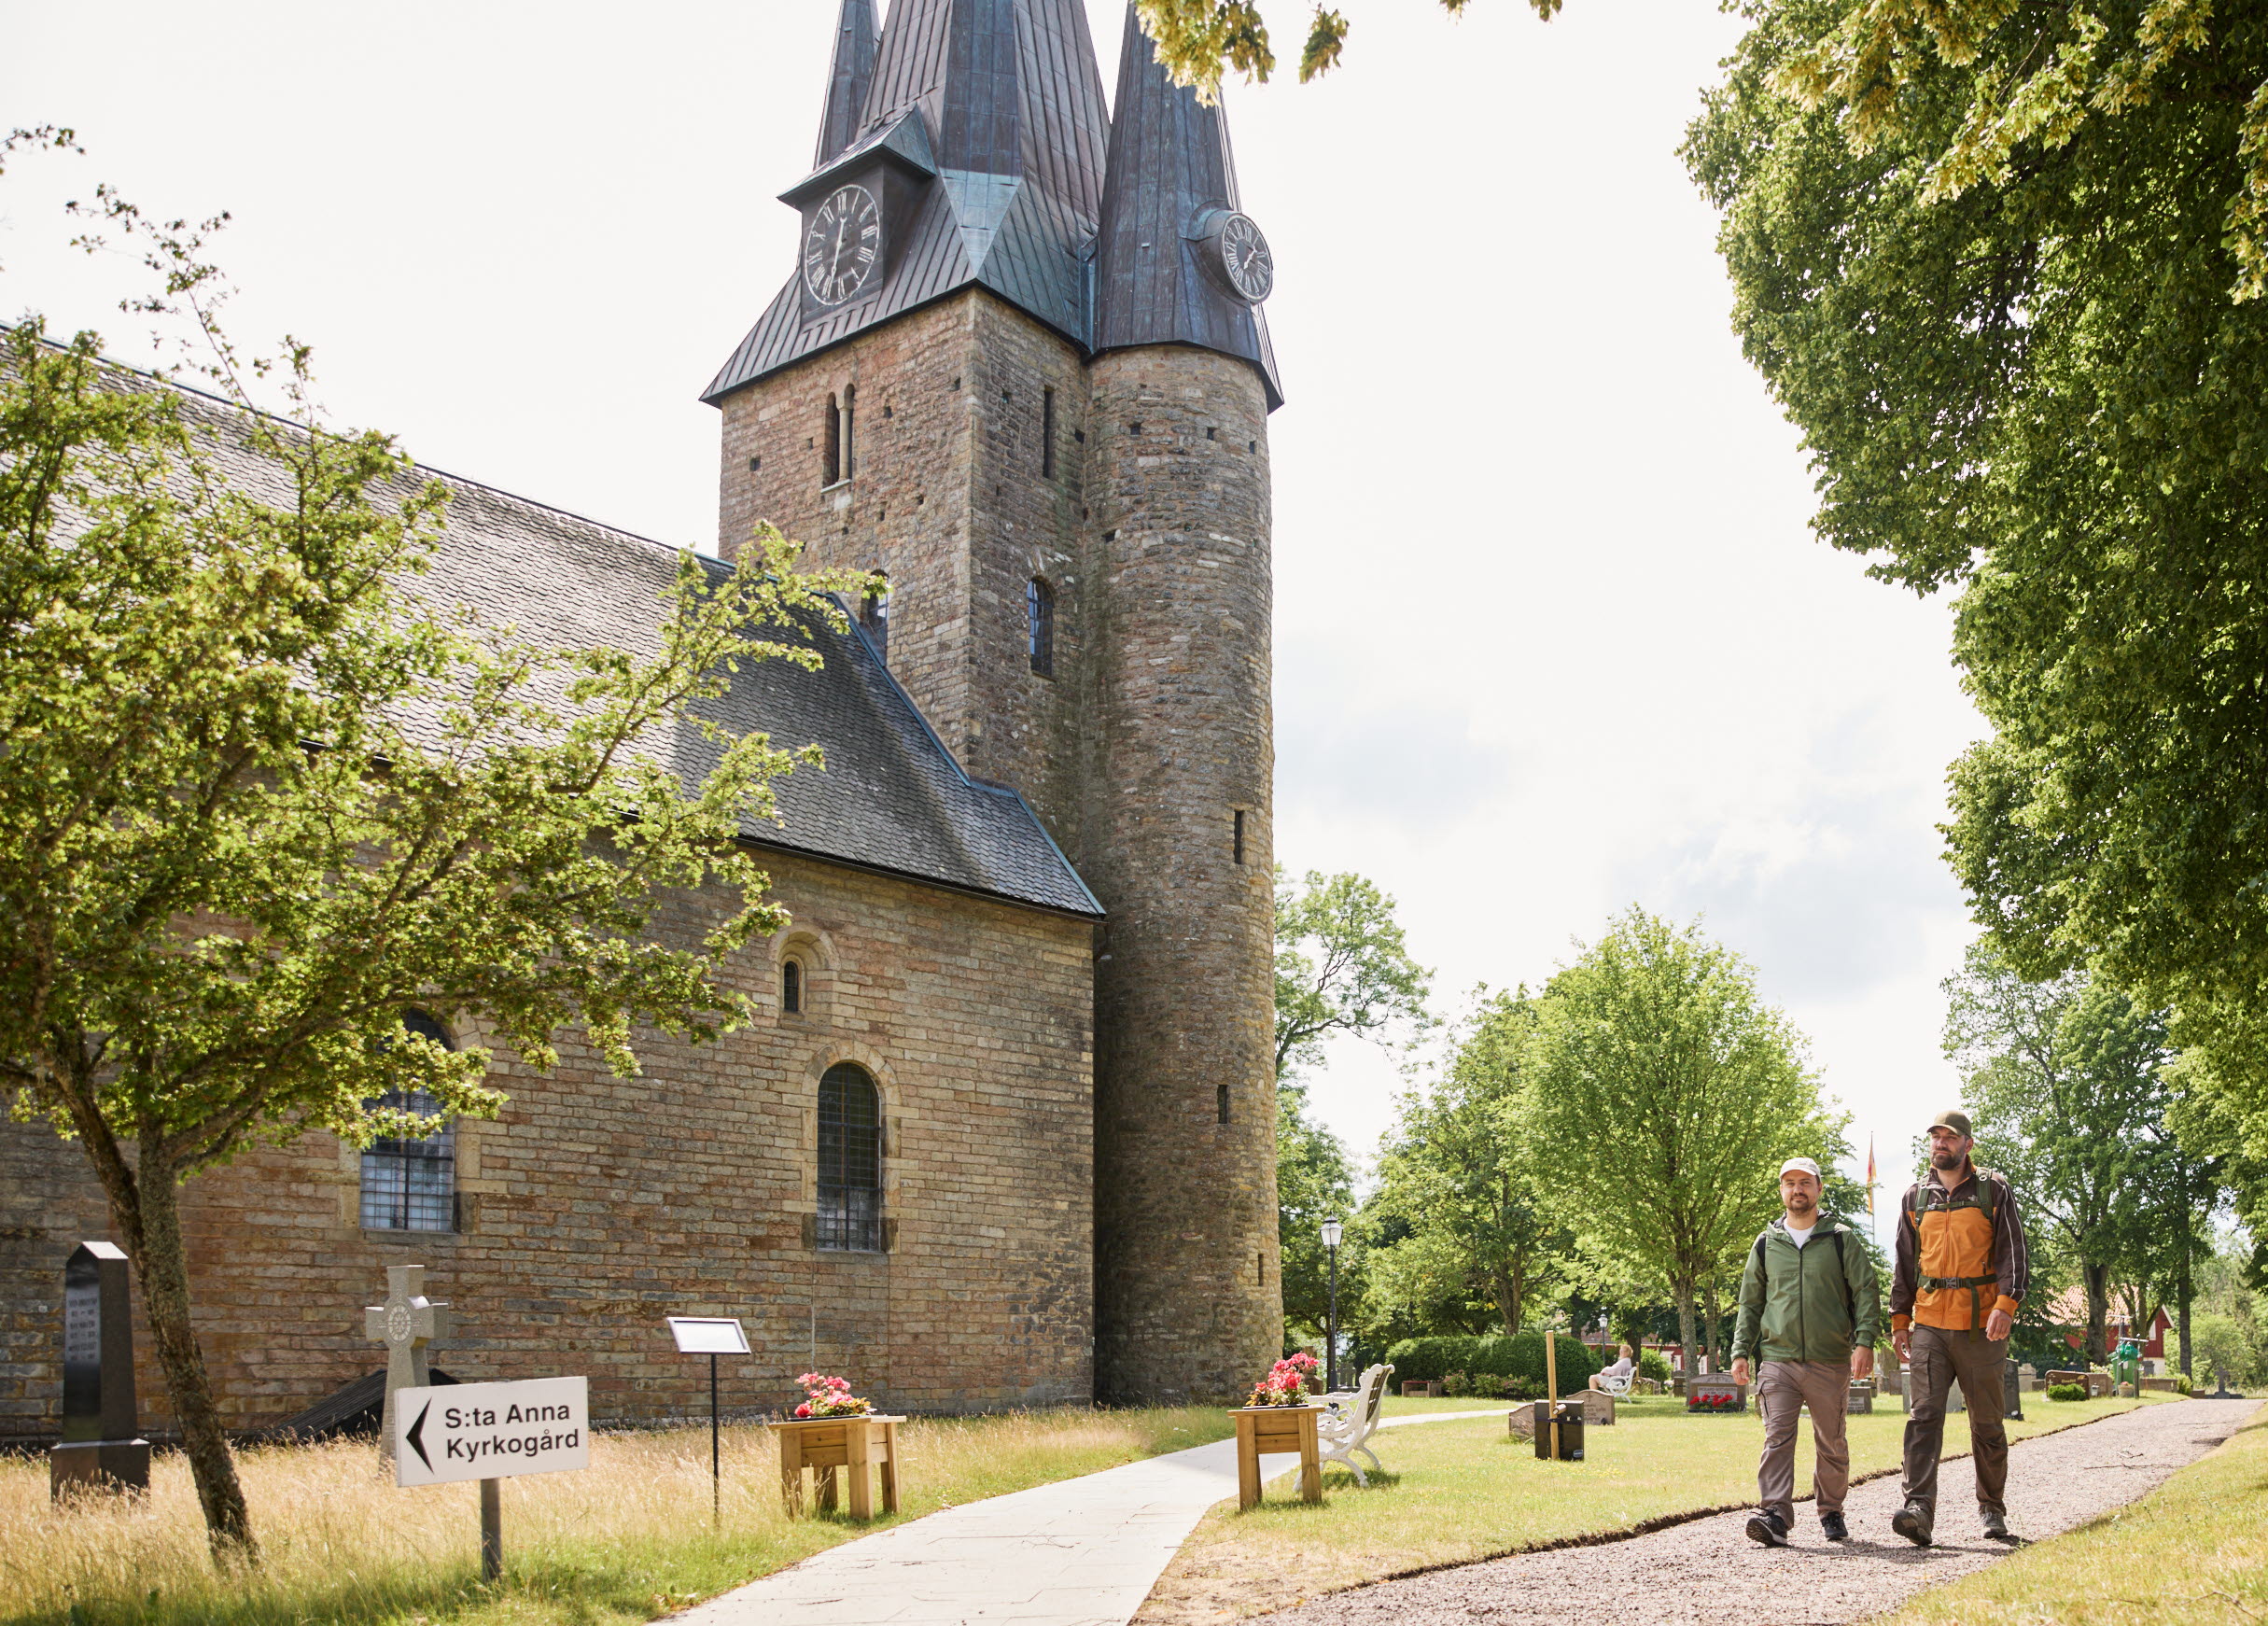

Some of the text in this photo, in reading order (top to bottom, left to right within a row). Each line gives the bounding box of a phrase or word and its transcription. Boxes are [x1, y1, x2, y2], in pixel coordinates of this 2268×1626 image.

[445, 1404, 570, 1429] S:ta Anna
[447, 1429, 580, 1463] Kyrkogård
